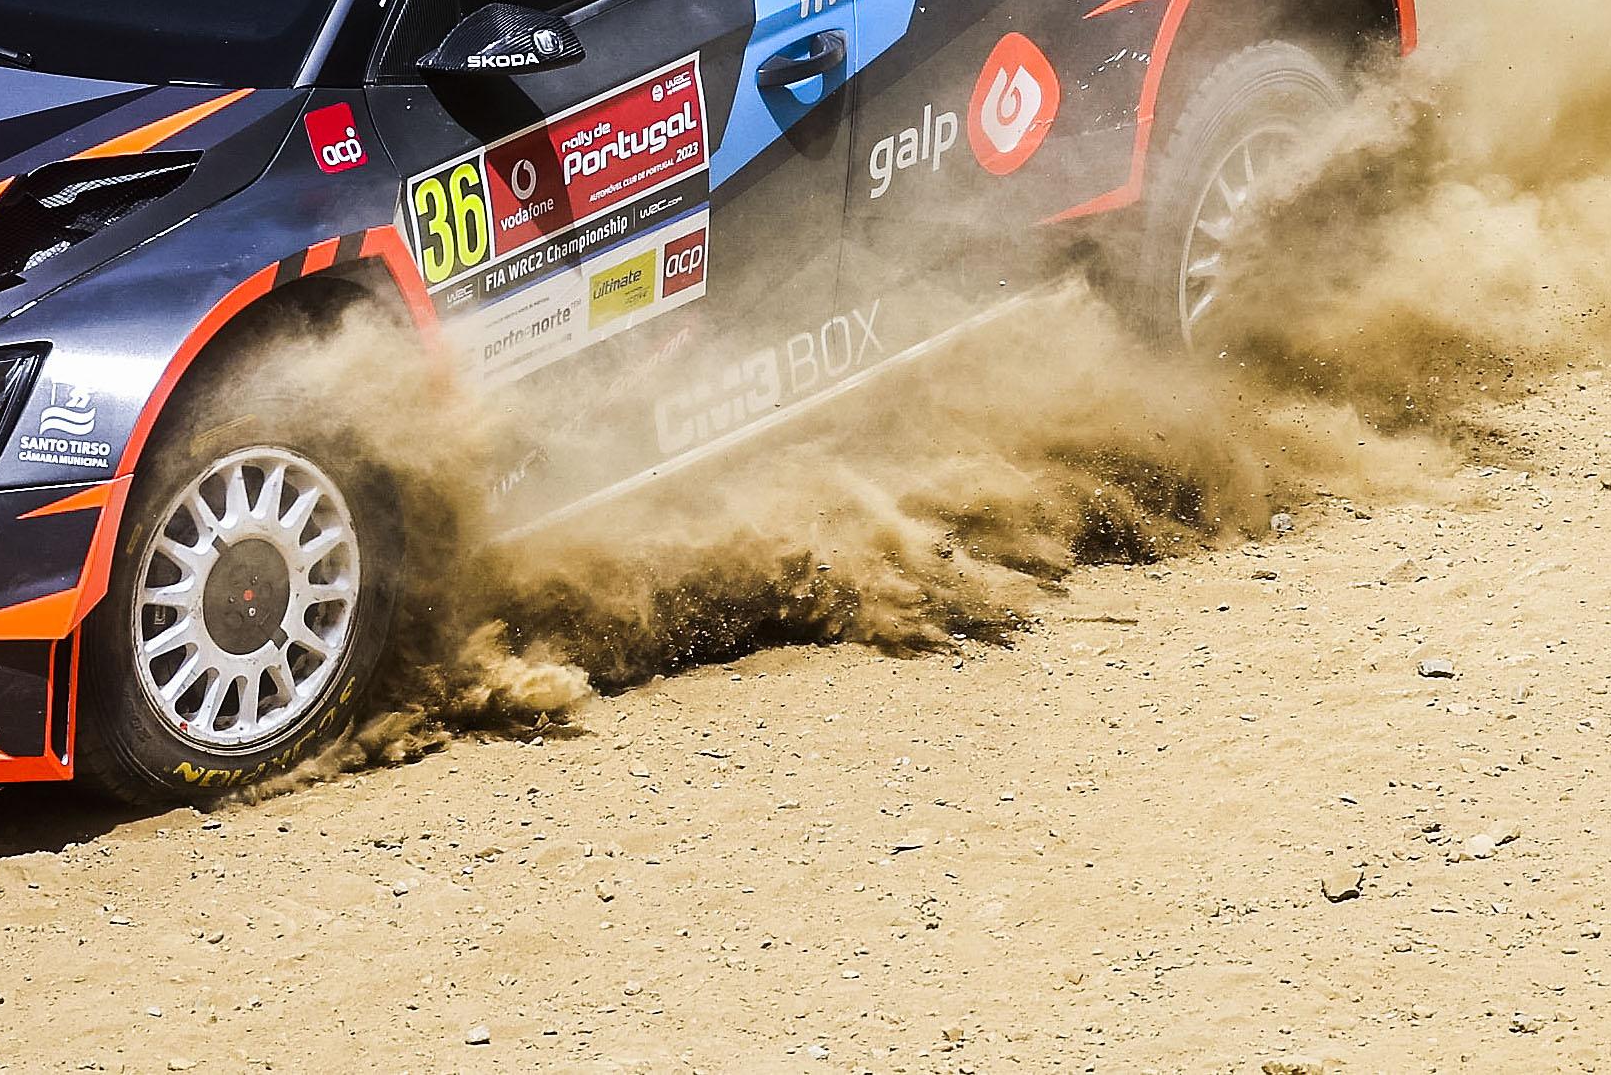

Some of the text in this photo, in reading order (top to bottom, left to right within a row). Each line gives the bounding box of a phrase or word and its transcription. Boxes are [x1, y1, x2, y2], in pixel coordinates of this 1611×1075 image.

[564, 101, 698, 186] Portugal
[594, 121, 611, 139] de
[322, 138, 362, 166] acp
[869, 104, 958, 200] galp
[414, 163, 490, 284] 36
[500, 197, 555, 232] vodafone
[485, 270, 506, 293] FIA
[509, 255, 543, 283] WRC2
[546, 215, 628, 264] Championship
[665, 244, 703, 278] acp
[788, 298, 886, 396] BOX
[19, 436, 111, 456] SANTO TIRSO
[59, 454, 109, 468] MUNICIPAL
